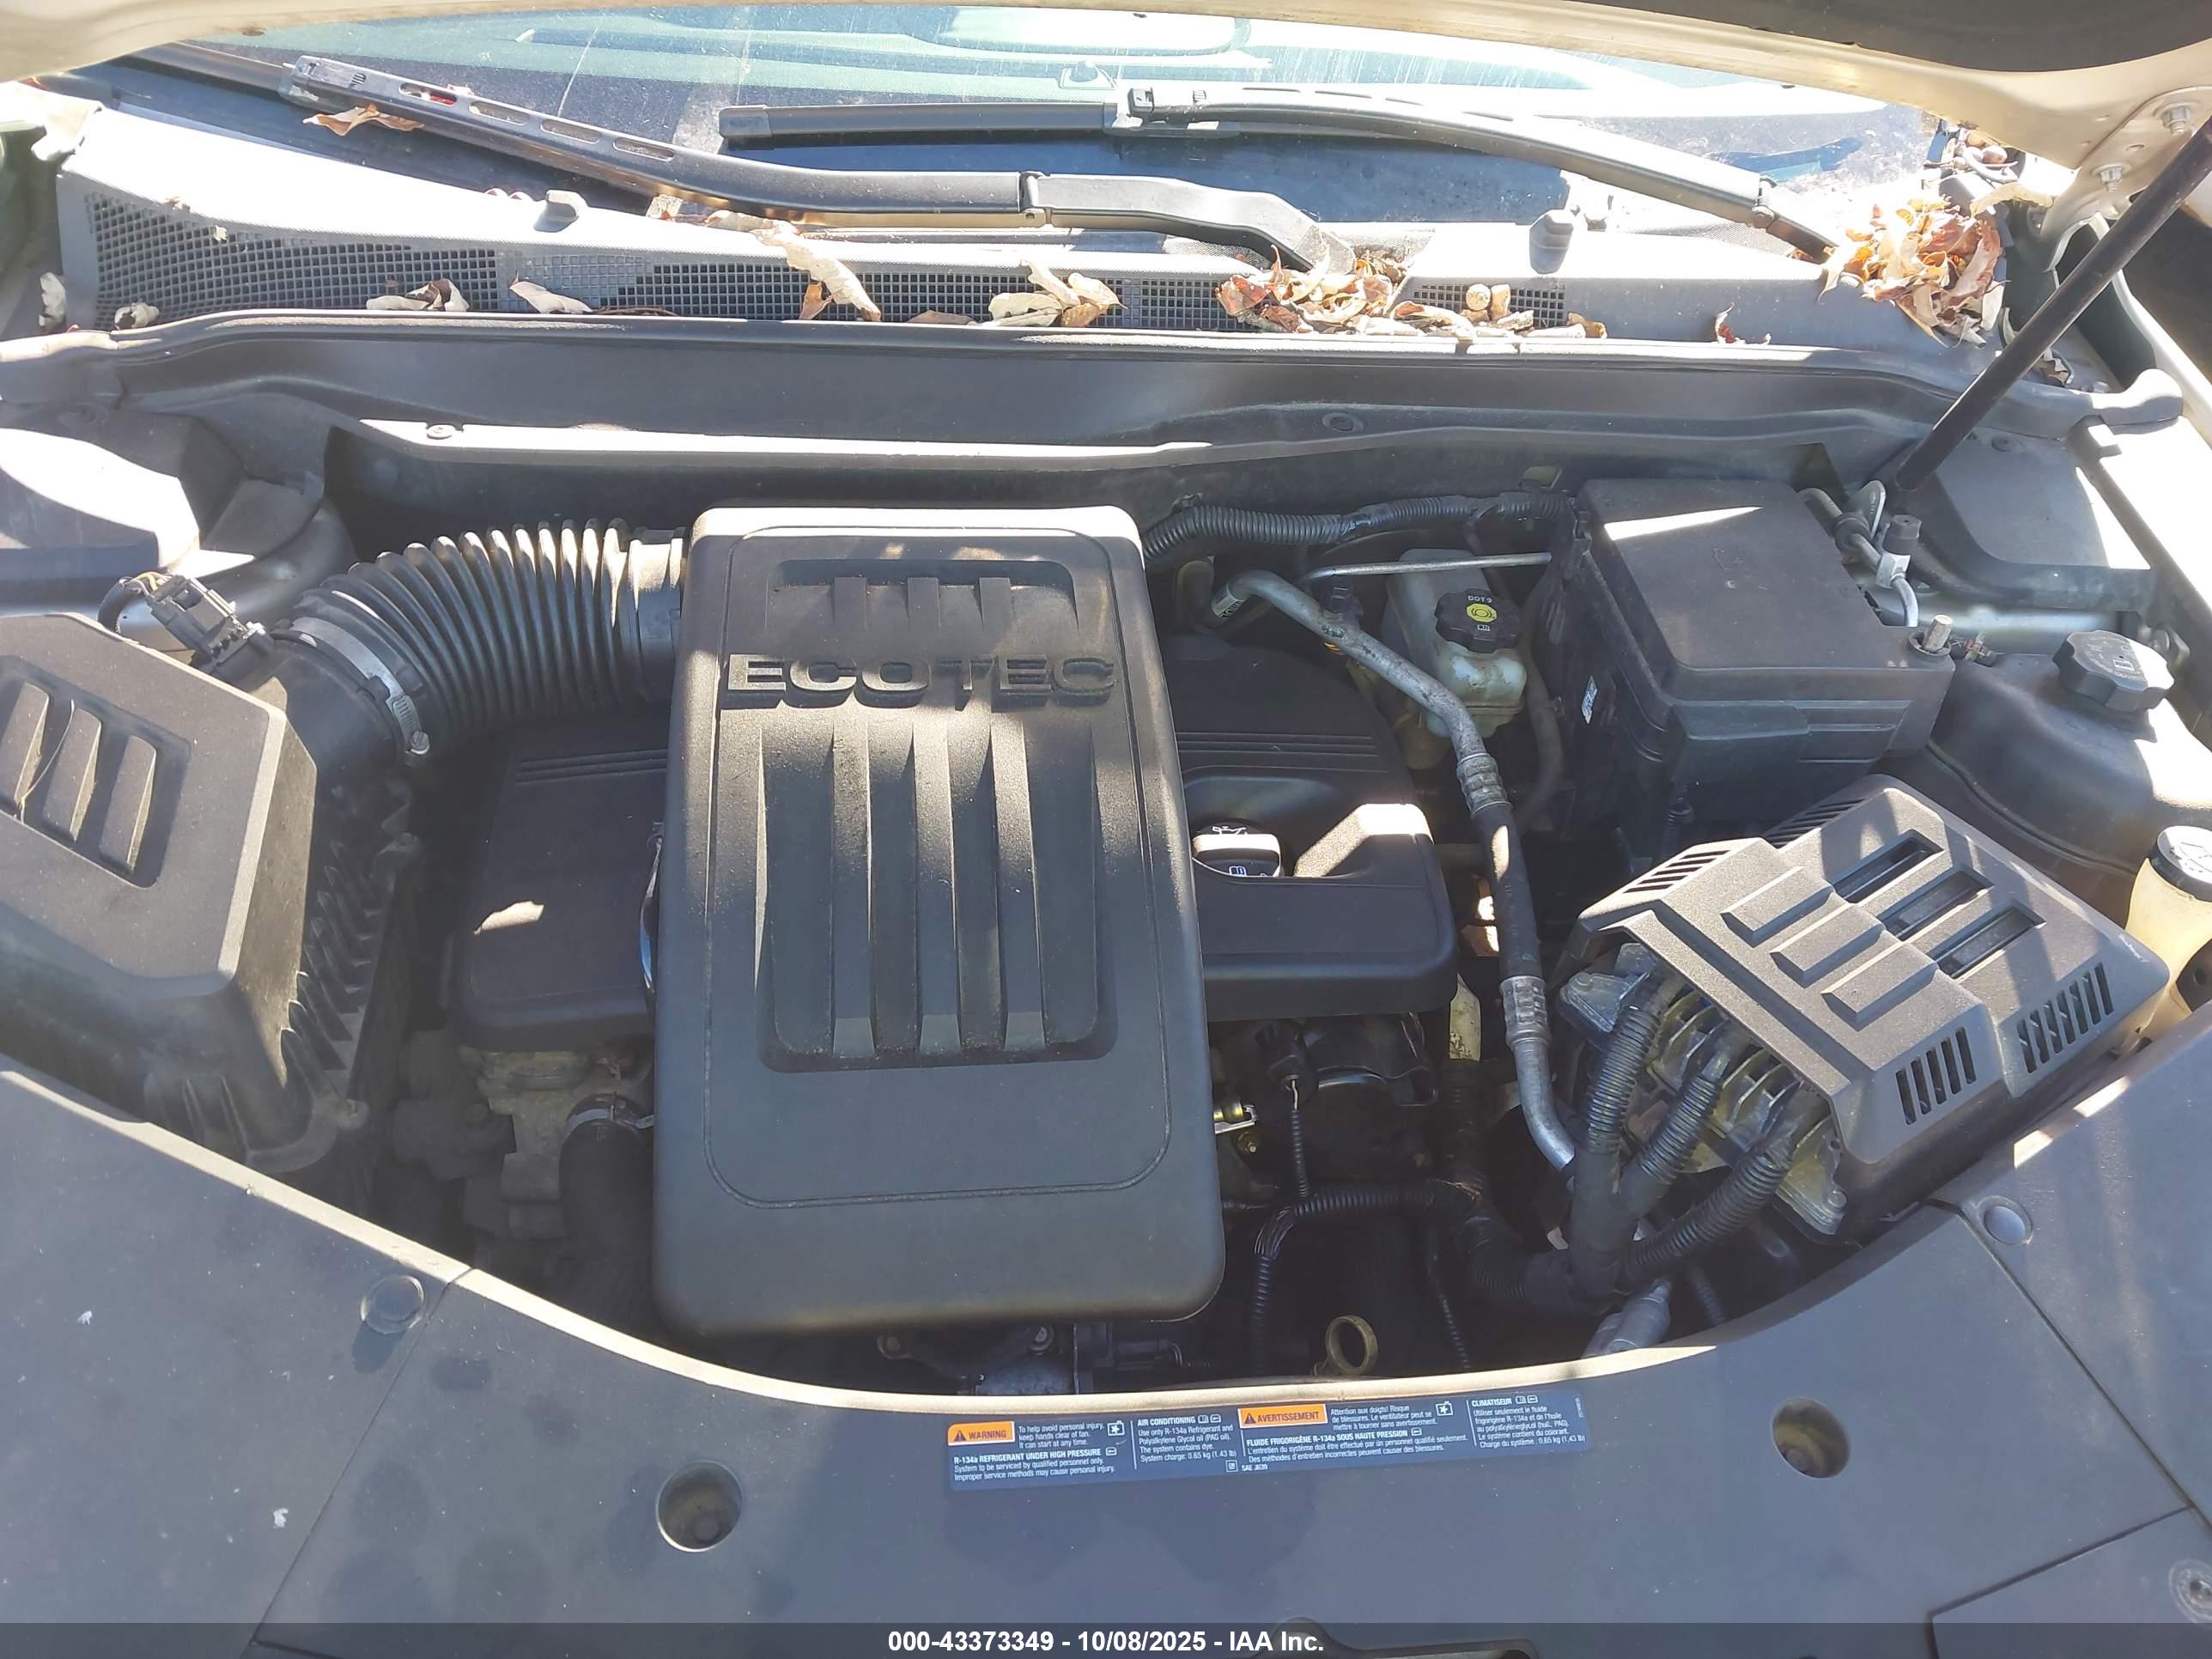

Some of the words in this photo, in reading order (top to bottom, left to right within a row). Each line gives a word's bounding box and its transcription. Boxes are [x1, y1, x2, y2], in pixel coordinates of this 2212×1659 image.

[727, 653, 1115, 695] ECOTEC
[1471, 1398, 1512, 1407] CLIMATISEUR
[1331, 1407, 1356, 1416] Attention
[1150, 1416, 1195, 1426] CONDITIONING
[1257, 1412, 1320, 1423] AVERTISSEMENT
[1060, 1423, 1085, 1432] personal
[1151, 1428, 1164, 1437] only
[1188, 1425, 1221, 1434] Refrigerant
[969, 1430, 1006, 1440] WARNING
[1019, 1433, 1034, 1442] keep
[1176, 1435, 1195, 1444] Glycol
[1205, 1434, 1218, 1443] (PAG
[1246, 1438, 1269, 1447] FLUIDE
[1313, 1434, 1335, 1443] R-134a
[1336, 1432, 1353, 1441] SOUS
[1354, 1431, 1376, 1440] HAUTE
[1376, 1429, 1407, 1438] PRESSION
[1385, 1437, 1413, 1448] personnel
[1152, 1444, 1175, 1455] system
[1201, 1443, 1214, 1451] dye.
[1325, 1449, 1358, 1458] incorrectes
[1358, 1448, 1382, 1457] peuvent
[954, 1455, 978, 1465] R-134a
[979, 1453, 1024, 1463] REFRIGERANT
[1025, 1451, 1048, 1461] UNDER
[1049, 1450, 1066, 1459] HIGH
[1066, 1448, 1102, 1458] PRESSURE
[1140, 1454, 1164, 1464] System
[1164, 1452, 1187, 1462] charge:
[1188, 1451, 1201, 1460] 0.65
[1212, 1449, 1228, 1459] (1.43
[954, 1464, 977, 1474] System
[996, 1462, 1021, 1470] serviced
[1031, 1459, 1058, 1469] qualified
[1060, 1457, 1089, 1468] personnel
[1091, 1456, 1104, 1466] only.
[954, 1473, 982, 1482] Improper
[983, 1471, 1006, 1480] service
[1007, 1469, 1034, 1478] methods
[1069, 1466, 1096, 1476] personal
